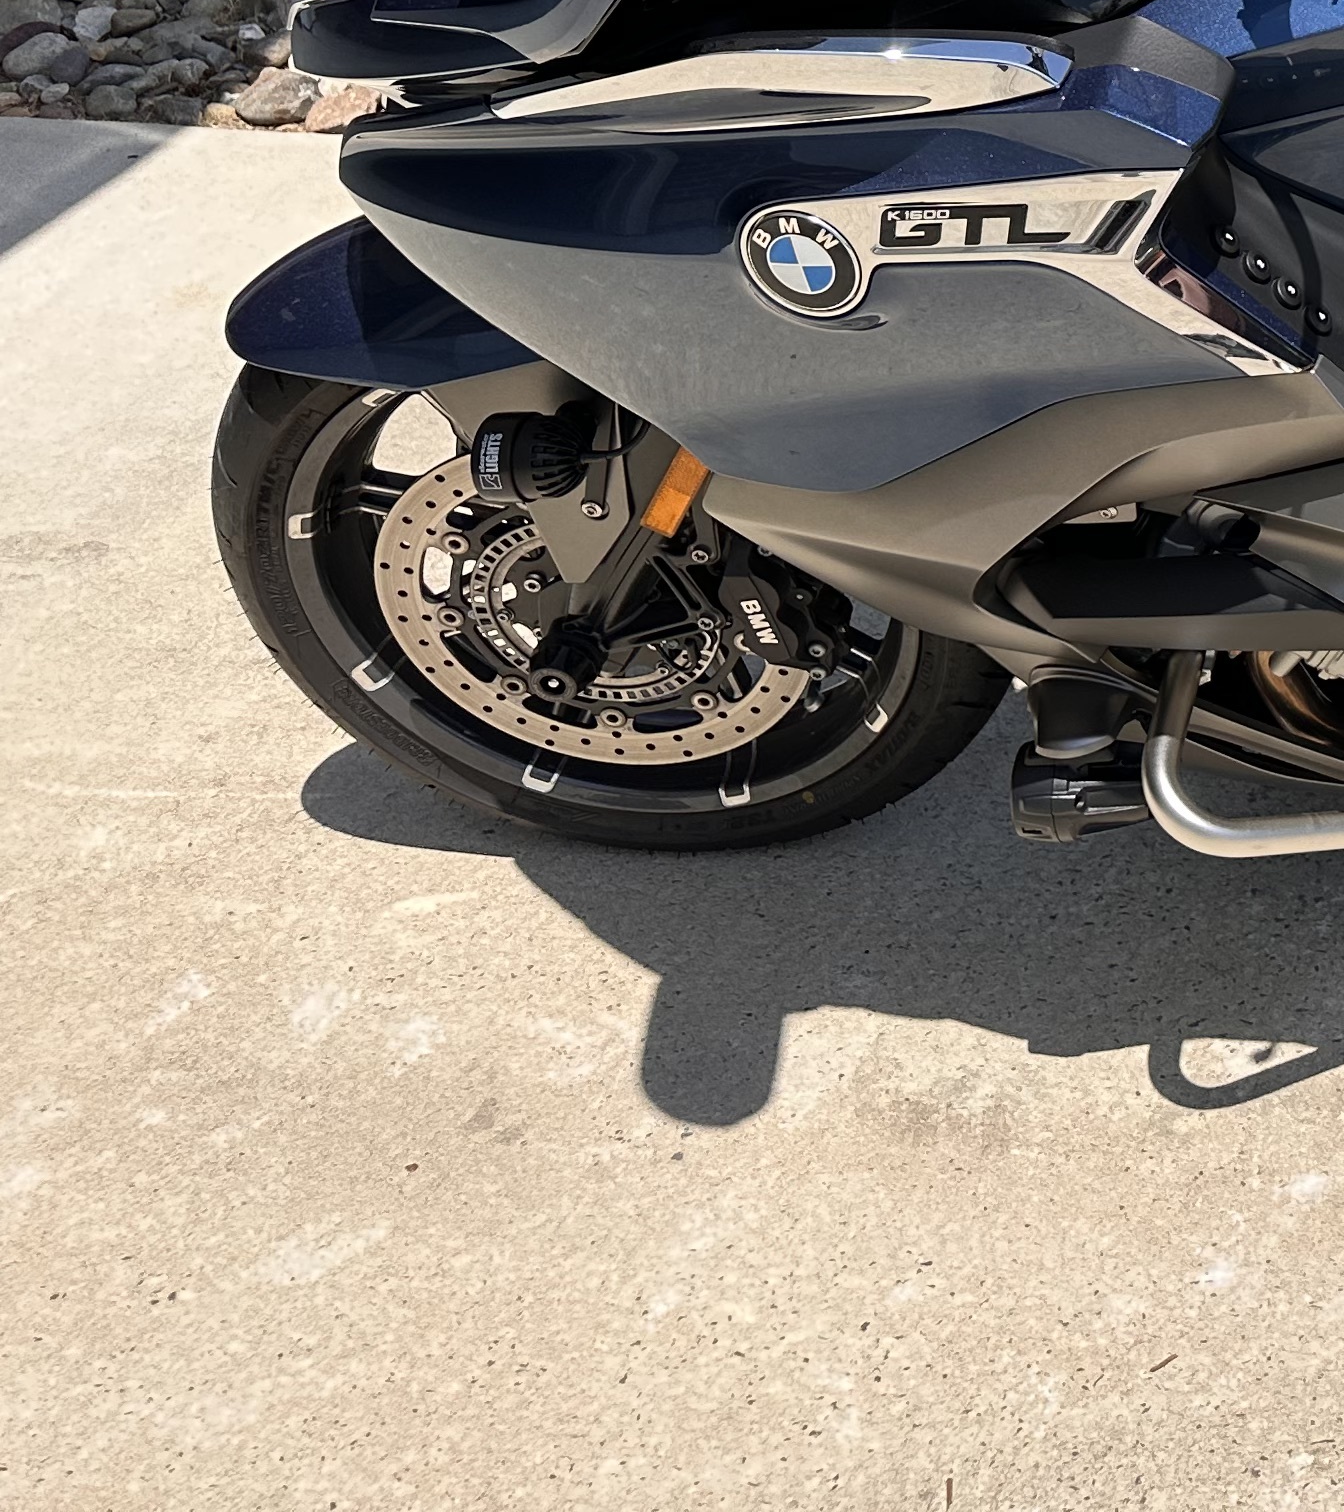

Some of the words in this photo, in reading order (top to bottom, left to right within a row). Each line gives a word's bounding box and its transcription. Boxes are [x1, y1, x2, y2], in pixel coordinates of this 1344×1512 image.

[752, 217, 840, 250] BMW
[879, 204, 1071, 247] GTL
[887, 210, 900, 221] K
[904, 209, 950, 220] 1600
[485, 432, 504, 473] LIGHTS
[740, 599, 779, 644] BMW
